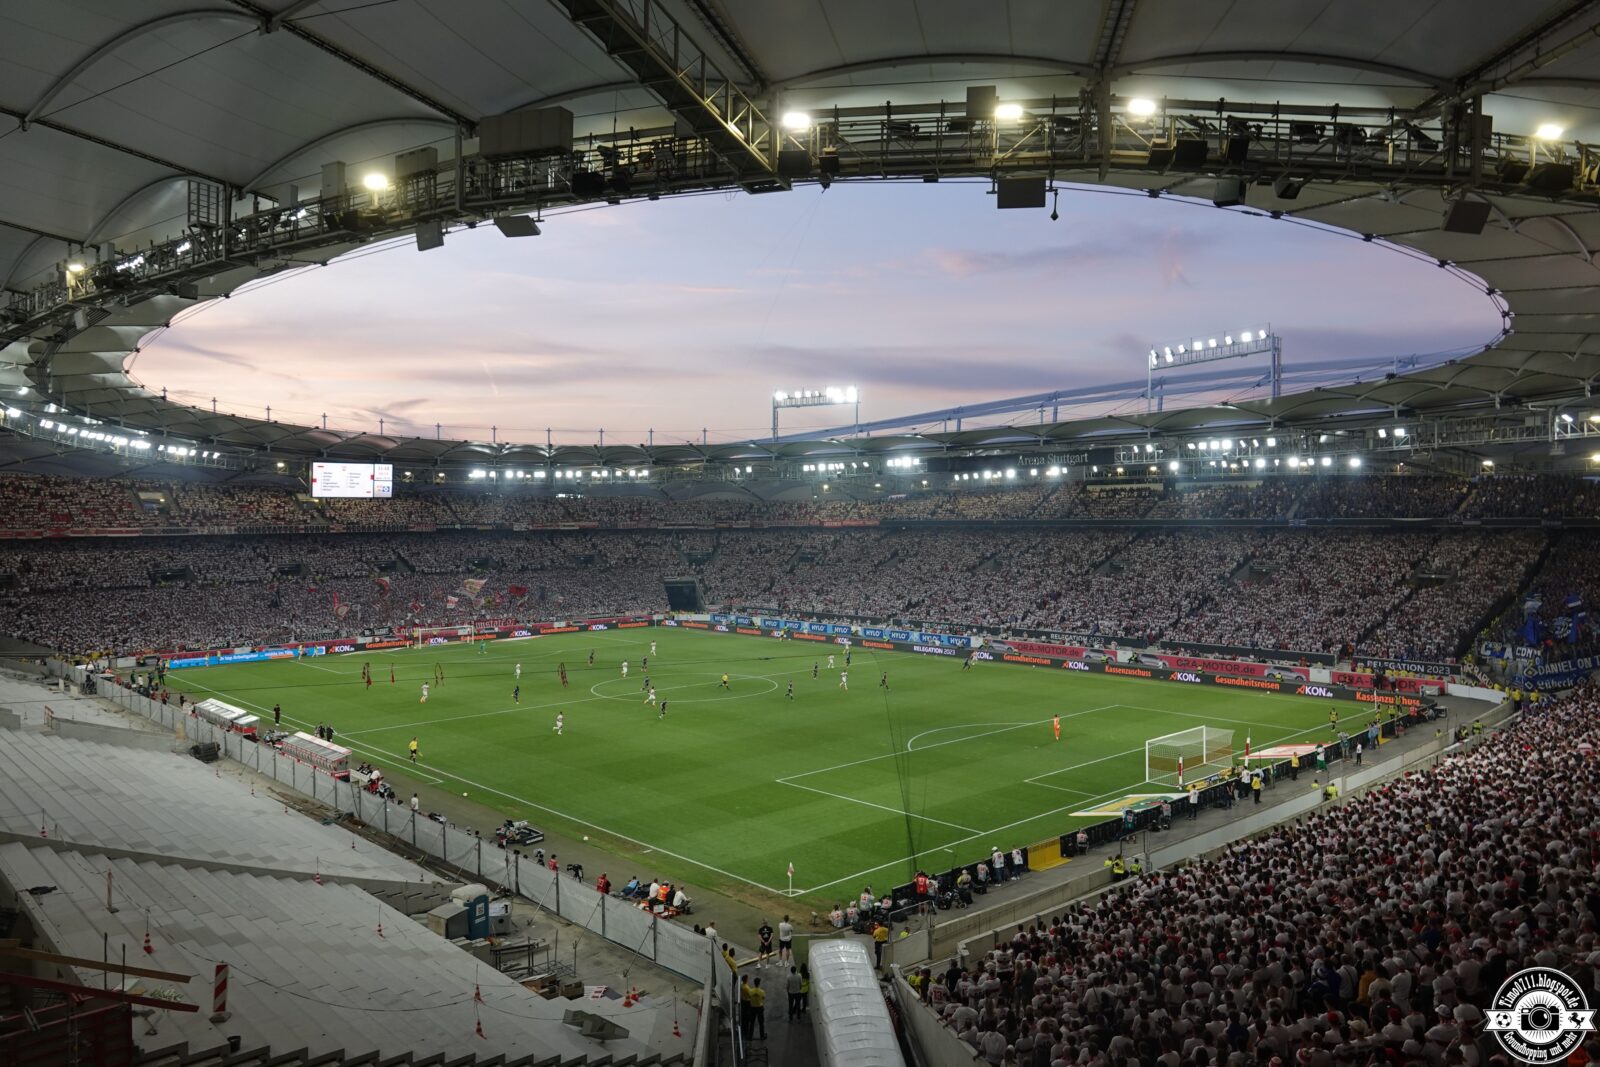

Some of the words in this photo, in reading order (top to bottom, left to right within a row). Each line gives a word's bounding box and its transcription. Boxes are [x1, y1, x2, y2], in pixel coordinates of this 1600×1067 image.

[1017, 455, 1045, 465] Arena
[1047, 452, 1089, 465] Stuttgart
[913, 645, 943, 654] RELEGATION
[974, 651, 993, 660] KON.de
[1105, 665, 1152, 677] Kassenzuschuss
[1427, 665, 1450, 675] 2023
[1538, 660, 1577, 676] DANIEL
[1577, 657, 1592, 669] ON
[1215, 675, 1280, 690] Gesundheitsreisen
[1355, 691, 1420, 705] Kassenzuhuss
